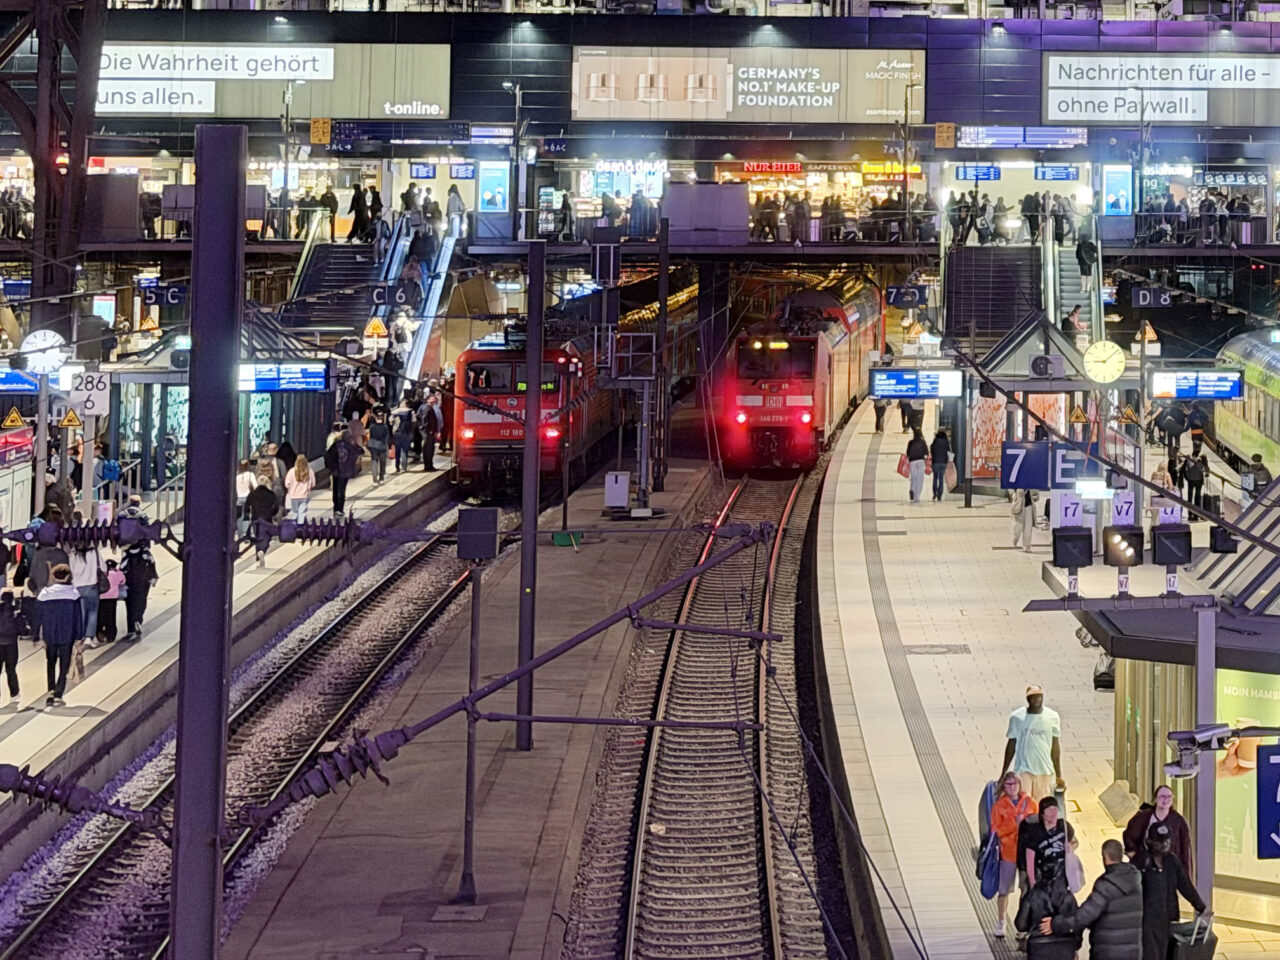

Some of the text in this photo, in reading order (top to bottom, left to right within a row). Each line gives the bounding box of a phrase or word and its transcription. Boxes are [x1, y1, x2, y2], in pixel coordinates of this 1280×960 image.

[99, 52, 320, 77] Die Wahrheit gehört
[1058, 63, 1183, 82] Nachrichten
[1187, 63, 1216, 82] für
[1221, 64, 1256, 82] alle
[738, 67, 820, 80] GERMANY'S
[865, 71, 893, 80] MAGIC
[776, 81, 840, 94] MAKE-UP
[97, 86, 204, 107] uns allen.
[738, 94, 833, 107] FOUNDATION
[384, 101, 445, 117] t-online.
[1057, 97, 1197, 117] ohne Paywall.
[744, 162, 802, 172] NUR HIER
[145, 288, 179, 304] 5 C
[372, 288, 406, 304] C 6
[888, 288, 897, 303] 7
[1139, 290, 1150, 306] D
[73, 375, 107, 391] 286
[84, 394, 96, 410] 6
[1006, 448, 1076, 484] 7 E
[1064, 502, 1080, 518] r7
[1115, 501, 1133, 517] v7
[1069, 578, 1077, 590] r7
[1119, 576, 1129, 589] v7
[1168, 575, 1177, 589] t7
[1223, 685, 1249, 697] MOIN
